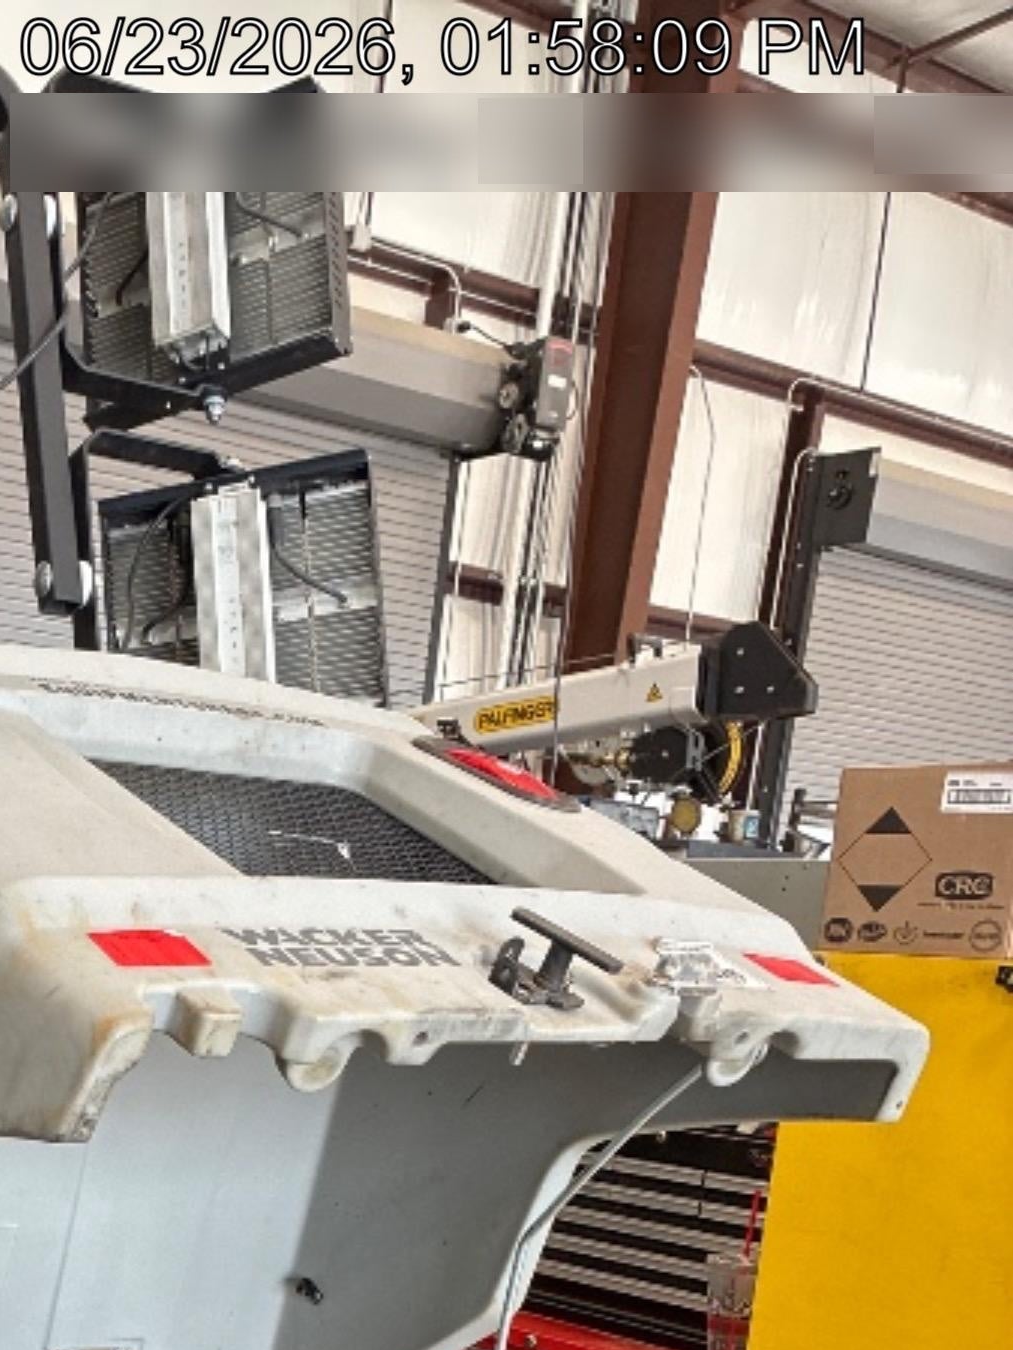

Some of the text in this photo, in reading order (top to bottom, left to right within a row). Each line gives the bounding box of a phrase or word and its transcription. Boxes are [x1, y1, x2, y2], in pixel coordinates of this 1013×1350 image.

[939, 874, 991, 897] CRC
[217, 927, 438, 948] WACKER
[244, 948, 462, 966] NEUSON
